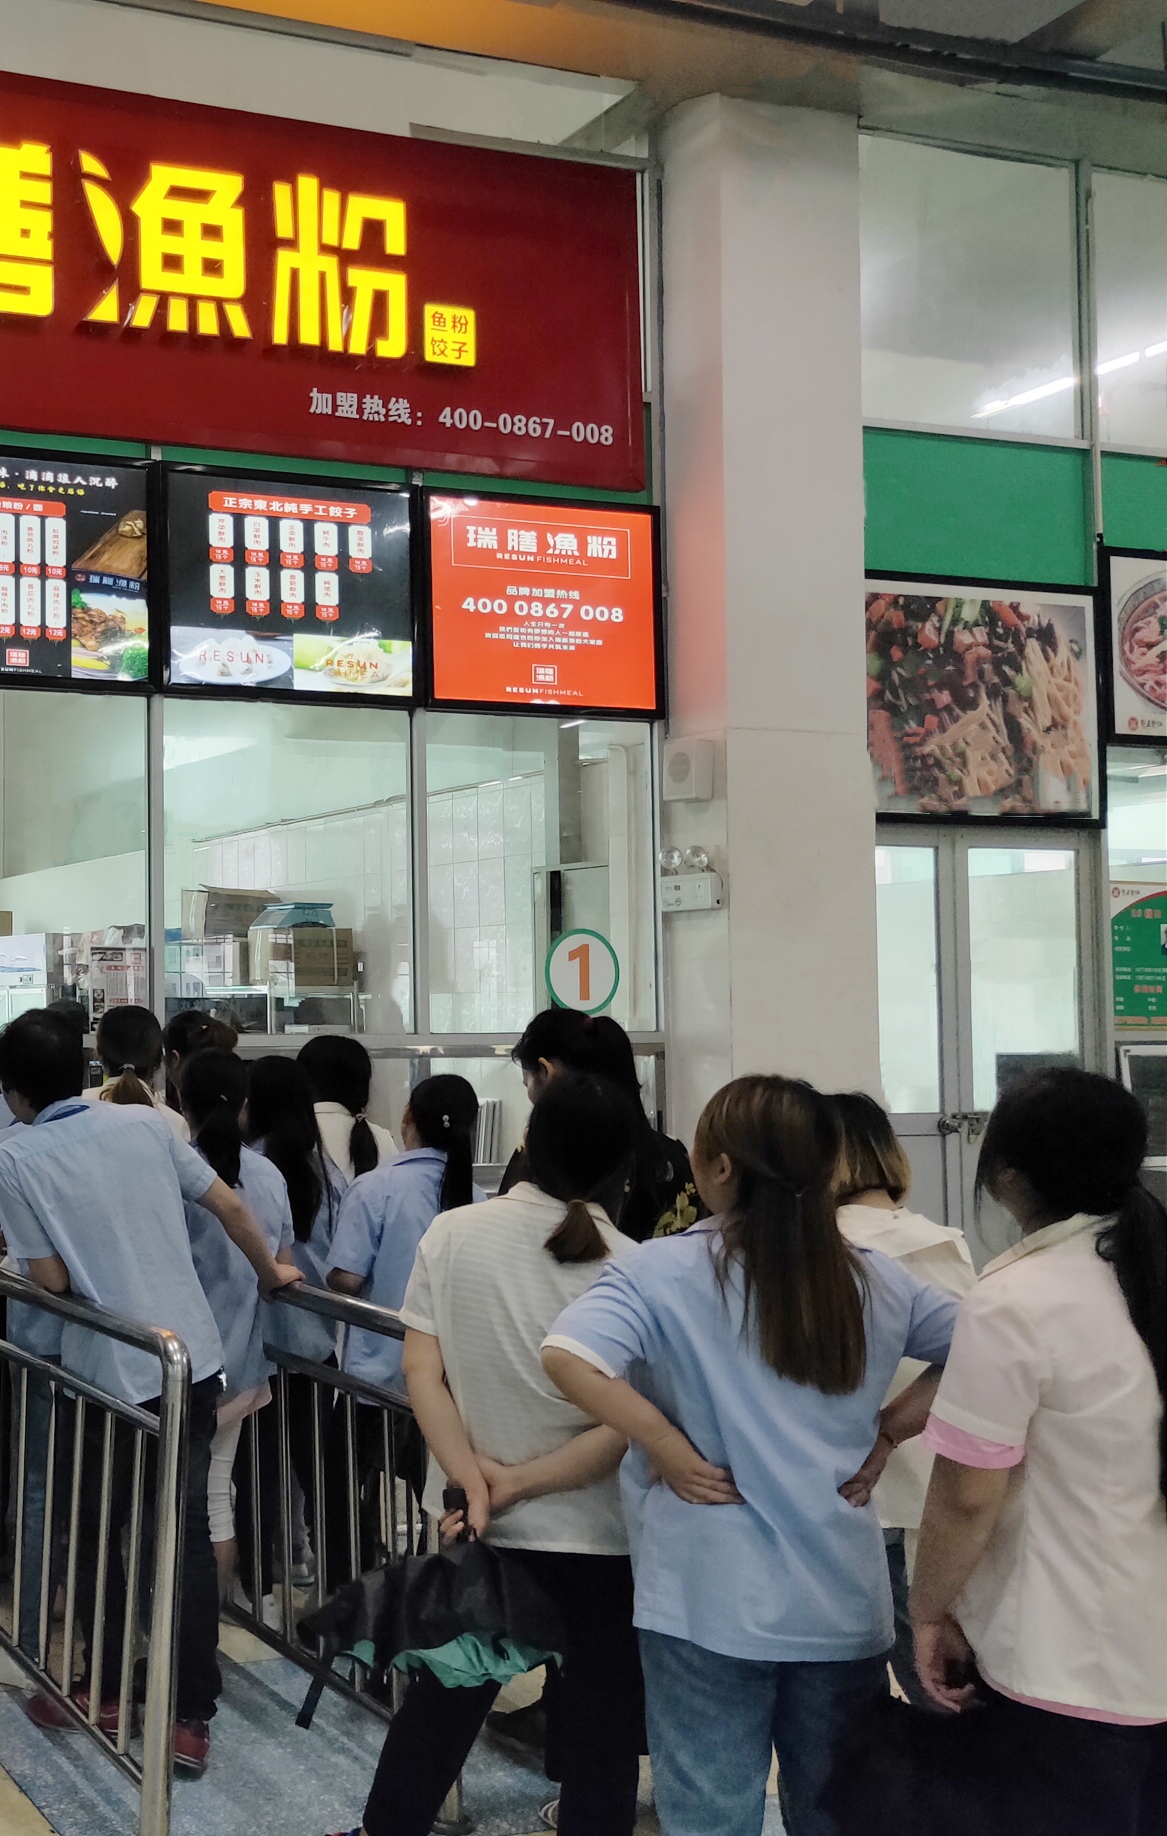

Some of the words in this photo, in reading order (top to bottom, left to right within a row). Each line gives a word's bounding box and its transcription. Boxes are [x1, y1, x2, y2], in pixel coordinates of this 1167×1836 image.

[430, 310, 469, 334] 鱼粉
[430, 336, 469, 359] 饺子
[438, 406, 614, 445] 400-0867-008
[465, 525, 617, 559] 瑞膳漁粉
[496, 552, 534, 562] RESUN
[536, 556, 588, 567] FISHMEAL
[506, 585, 581, 600] 品牌加盟热线
[461, 597, 508, 615] 400
[514, 600, 574, 619] 0867
[579, 605, 624, 623] 008
[199, 650, 265, 664] RESUN
[325, 659, 379, 669] RESUN
[567, 943, 591, 1001] 1
